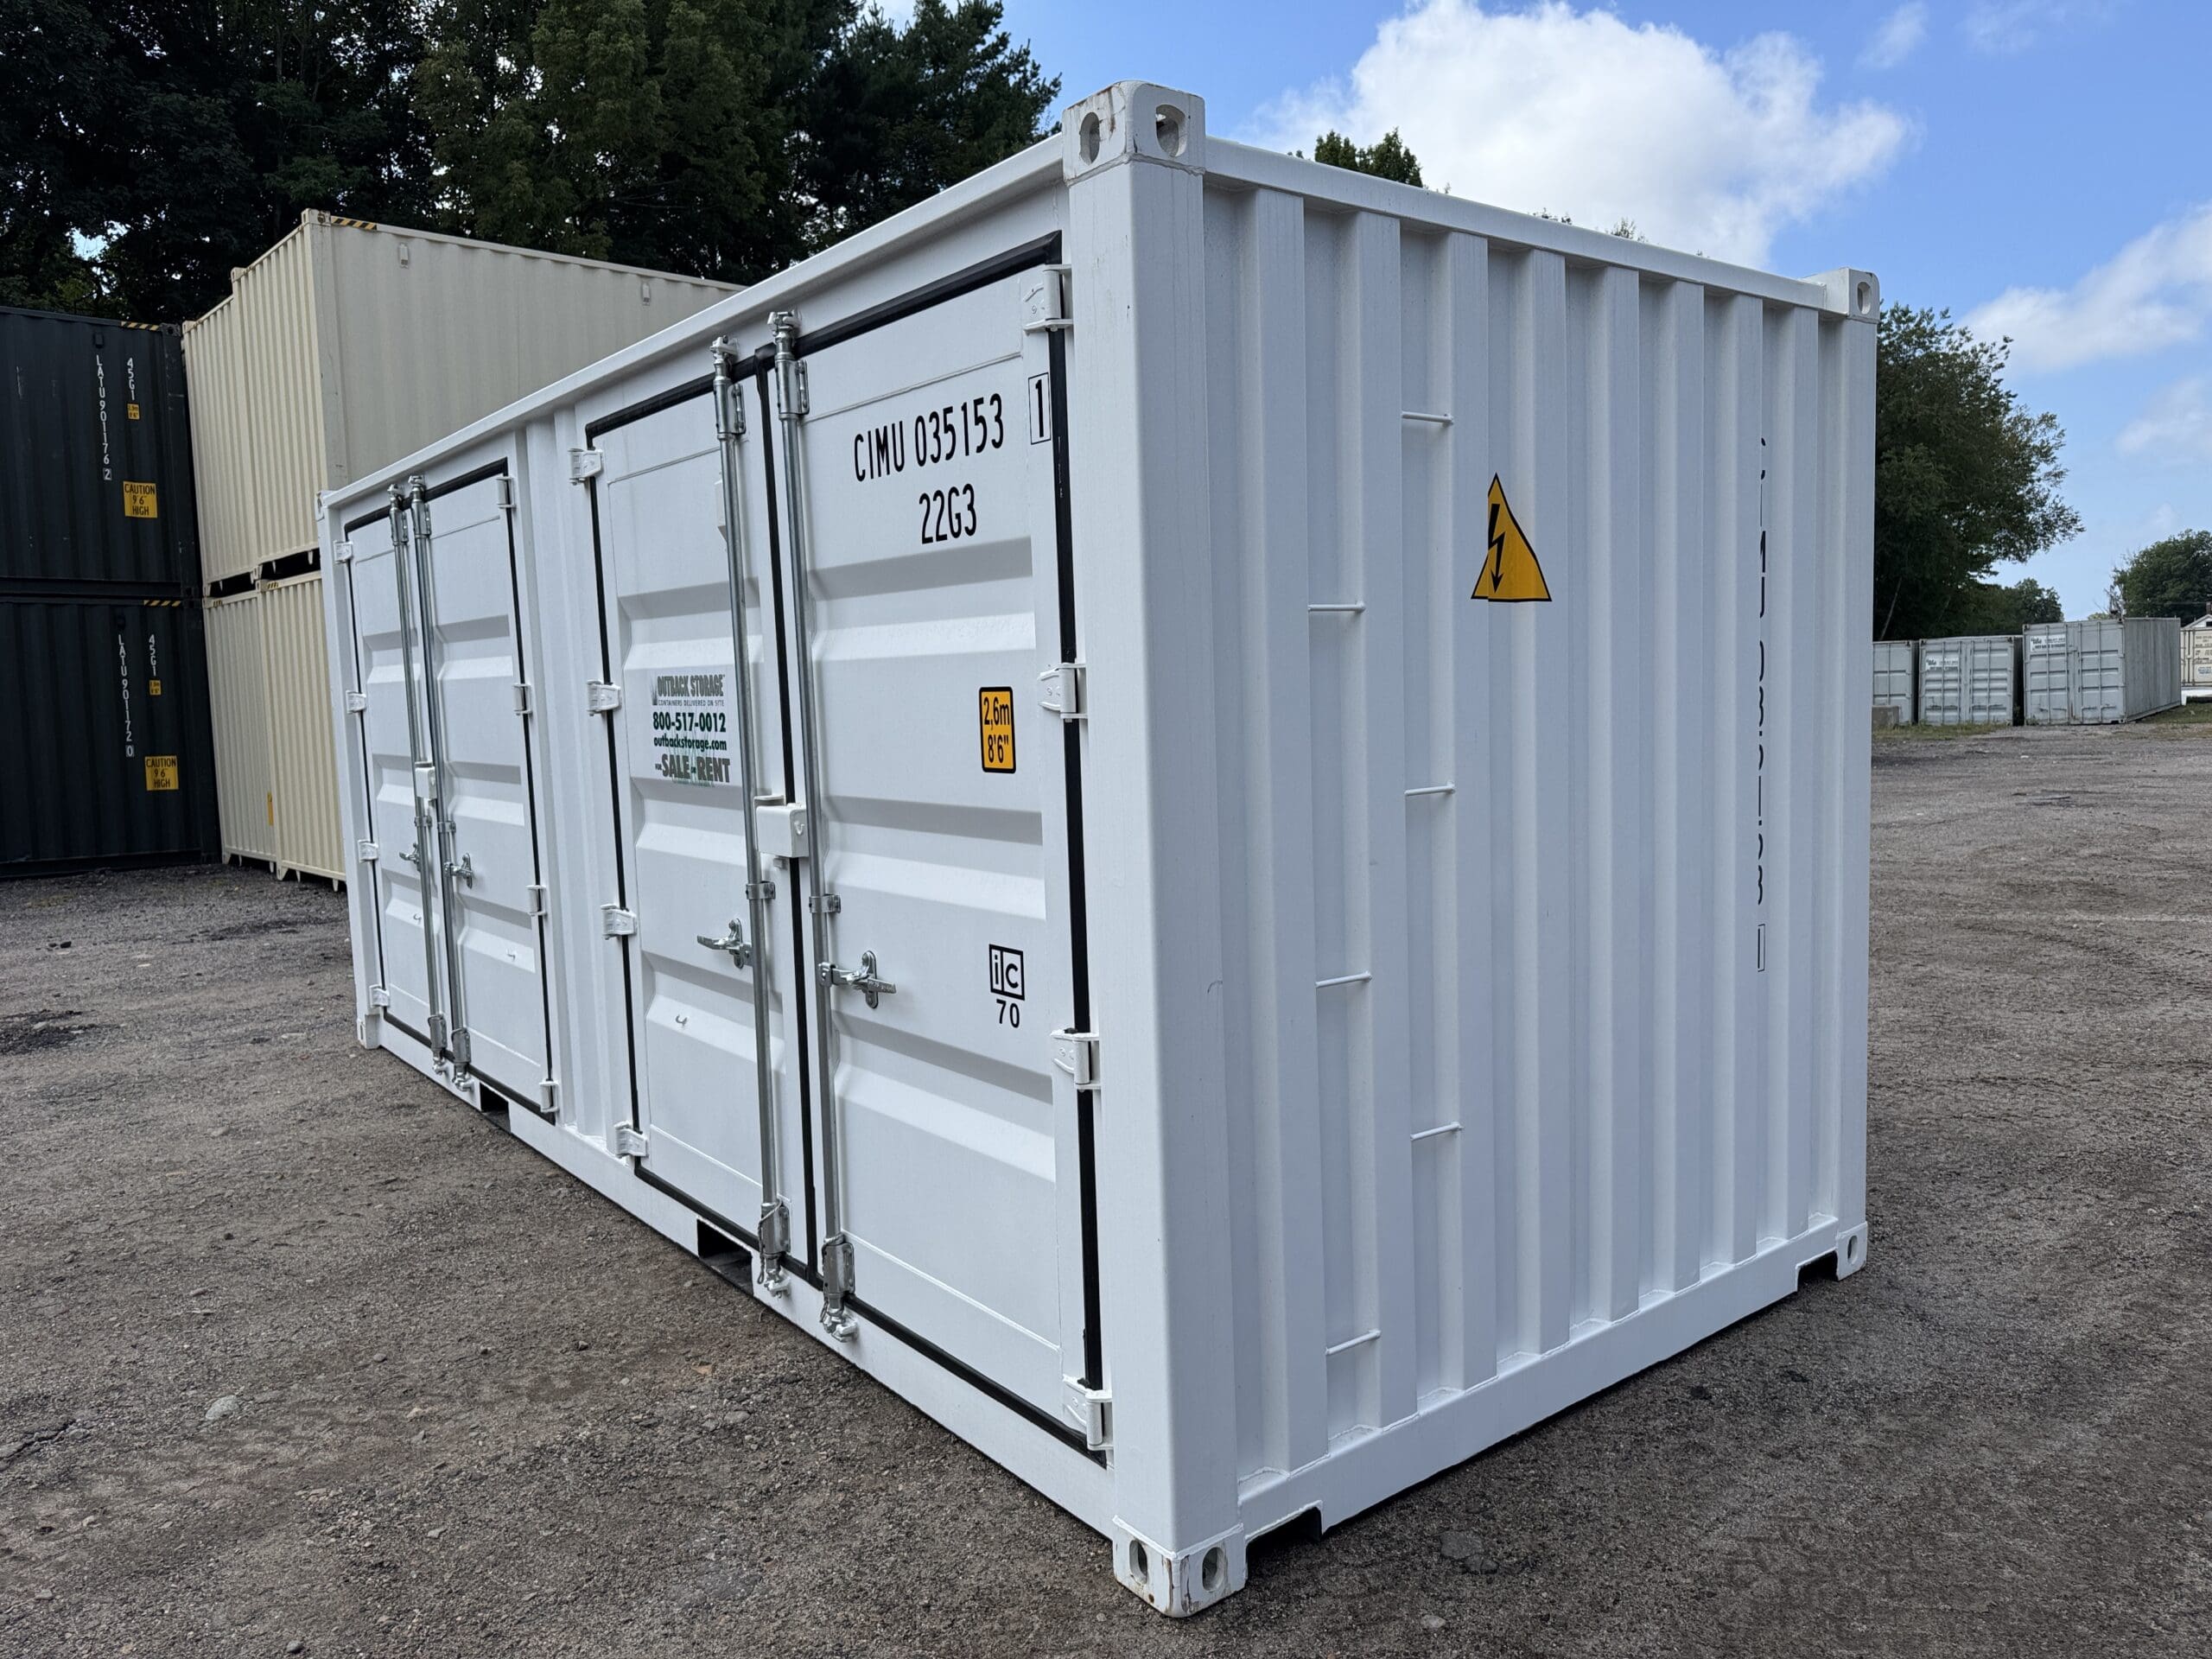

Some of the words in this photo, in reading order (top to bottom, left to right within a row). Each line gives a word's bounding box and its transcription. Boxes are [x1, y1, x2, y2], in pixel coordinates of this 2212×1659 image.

[96, 354, 105, 398] LATU
[99, 399, 110, 465] 901176
[854, 421, 906, 482] CIMU
[914, 393, 1004, 467] 035153
[1035, 378, 1044, 438] 1
[105, 468, 111, 480] 2
[124, 484, 156, 495] CAUTION
[132, 505, 149, 517] HIGH
[918, 483, 977, 544] 22G3
[118, 634, 127, 677] LATU
[657, 676, 690, 697] OUTBACK
[690, 674, 724, 697] STORAGE
[122, 678, 132, 742] 901172
[652, 711, 727, 733] 800-517-0012
[983, 696, 1010, 731] 2,6m
[126, 745, 134, 757] 0
[653, 733, 728, 753] outbackstorage.com
[988, 734, 1009, 764] 8'6"
[145, 758, 177, 768] CAUTION
[661, 753, 691, 779] SALE
[696, 756, 731, 784] RENT
[154, 778, 171, 789] HIGH
[995, 998, 1020, 1028] 70
